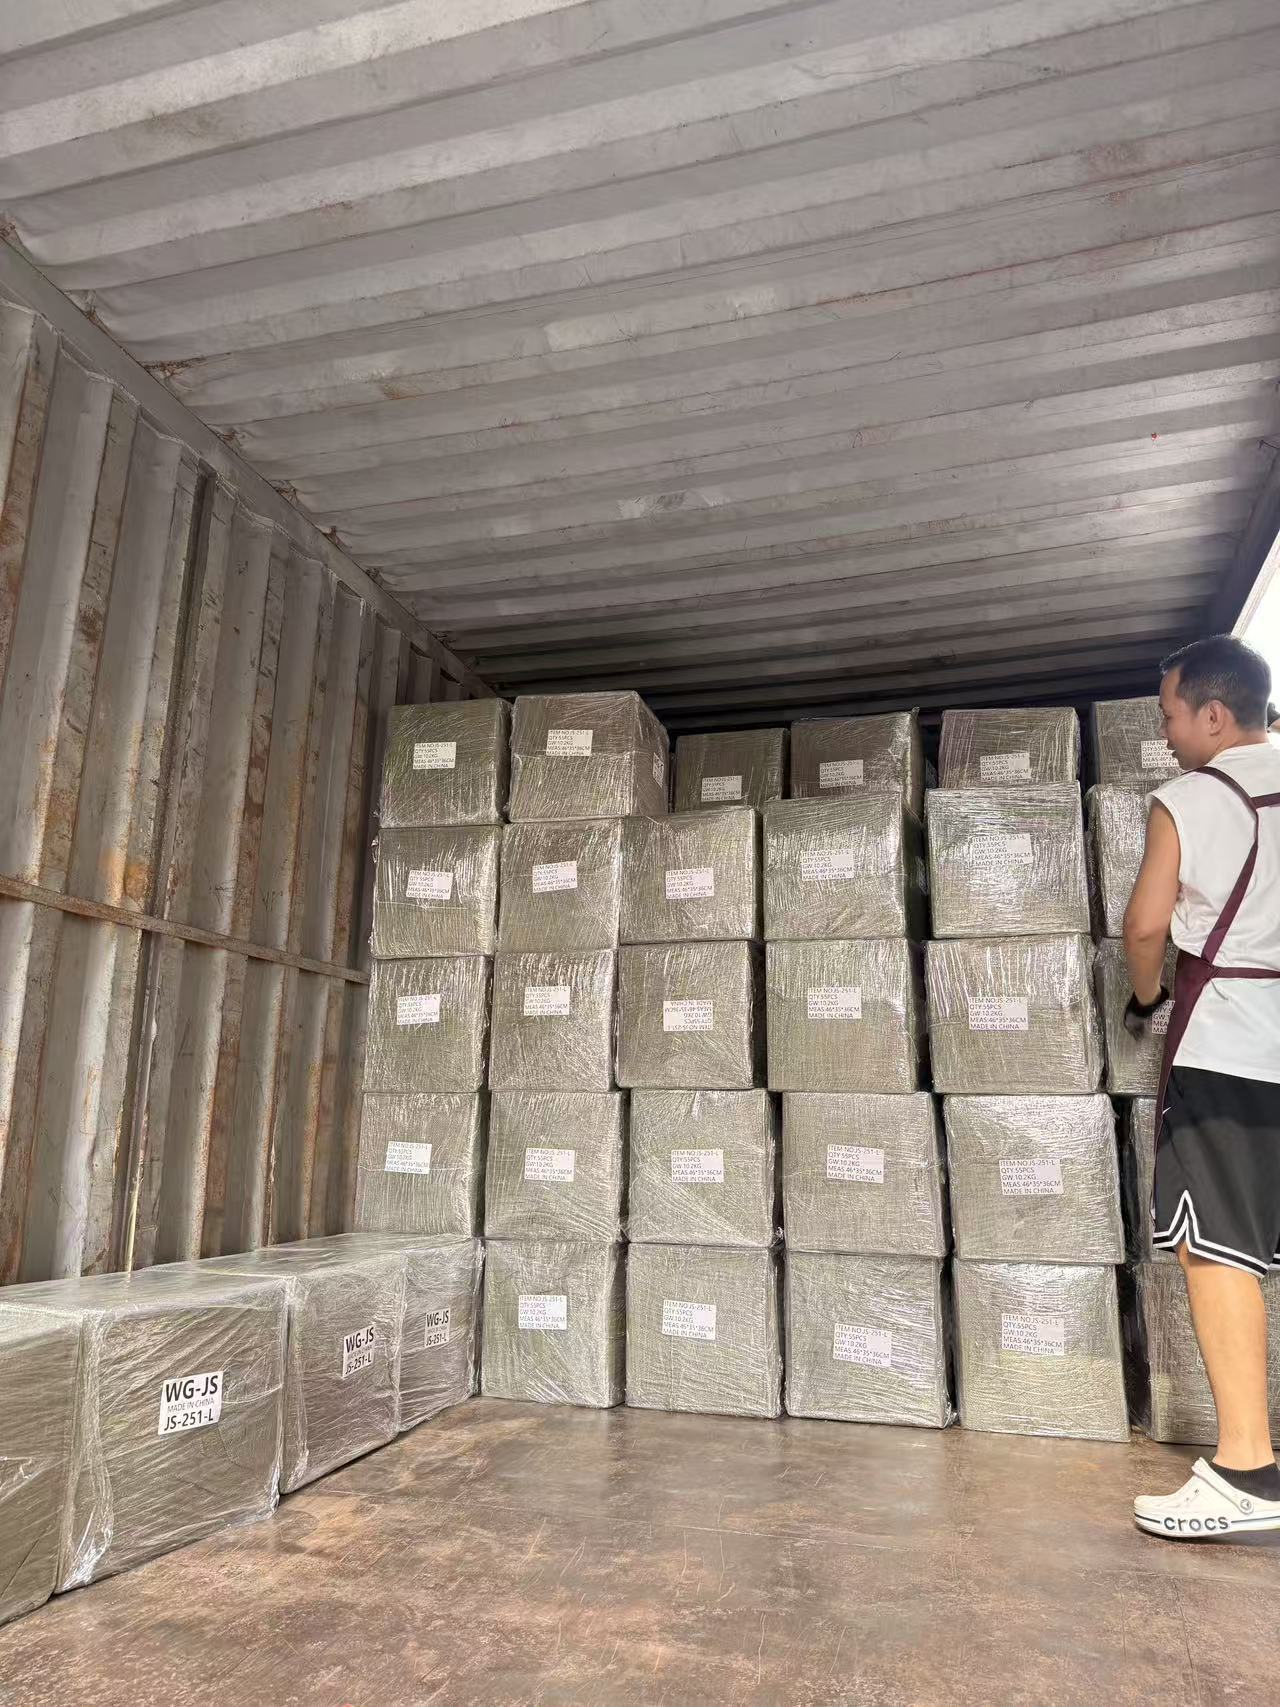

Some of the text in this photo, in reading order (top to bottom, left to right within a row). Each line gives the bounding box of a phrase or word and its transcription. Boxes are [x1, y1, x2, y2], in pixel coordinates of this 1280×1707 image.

[427, 1310, 448, 1327] WG-JS
[346, 1327, 374, 1353] WG-JS
[426, 1333, 446, 1346] JS-251-L
[1033, 1346, 1055, 1354] CHINA
[346, 1352, 371, 1374] JS-251-L
[834, 1352, 852, 1360] MADE
[862, 1356, 882, 1365] CHINA
[166, 1375, 218, 1402] WG-JS
[168, 1403, 186, 1412] MADE
[195, 1397, 214, 1407] CHINA
[164, 1408, 213, 1431] JS-251-L
[1164, 1517, 1228, 1531] crocs
